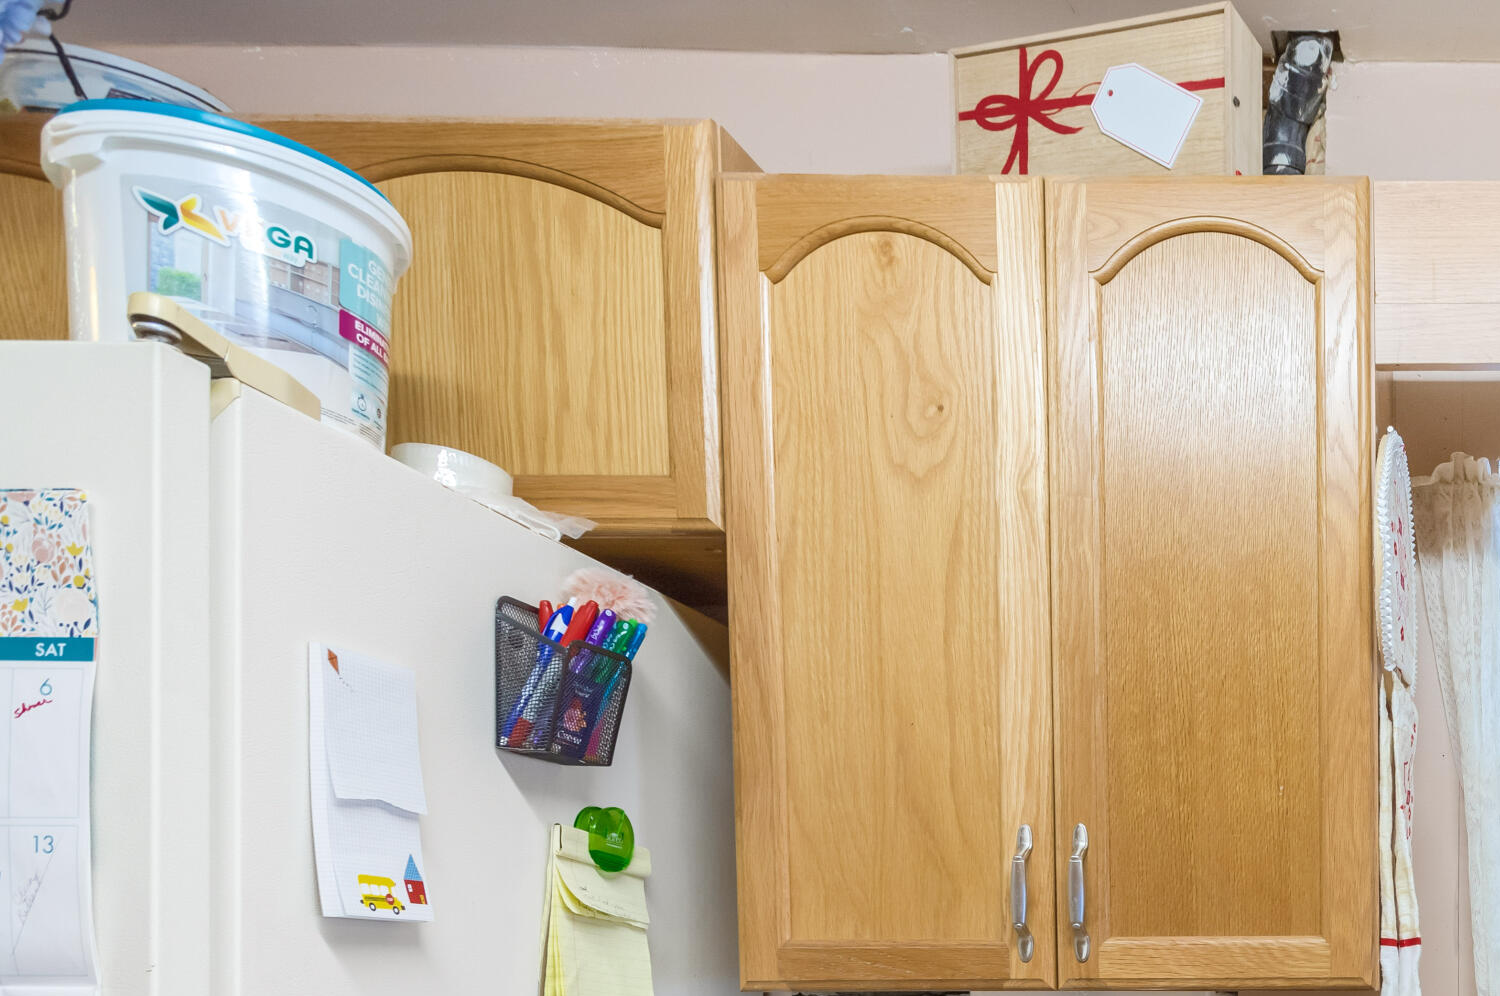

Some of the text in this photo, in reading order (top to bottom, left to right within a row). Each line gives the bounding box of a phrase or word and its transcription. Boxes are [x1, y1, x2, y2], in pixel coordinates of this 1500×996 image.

[219, 209, 314, 260] VGA
[356, 333, 370, 347] OF
[35, 642, 67, 657] SAT
[40, 678, 53, 696] 6
[33, 835, 54, 854] 13
